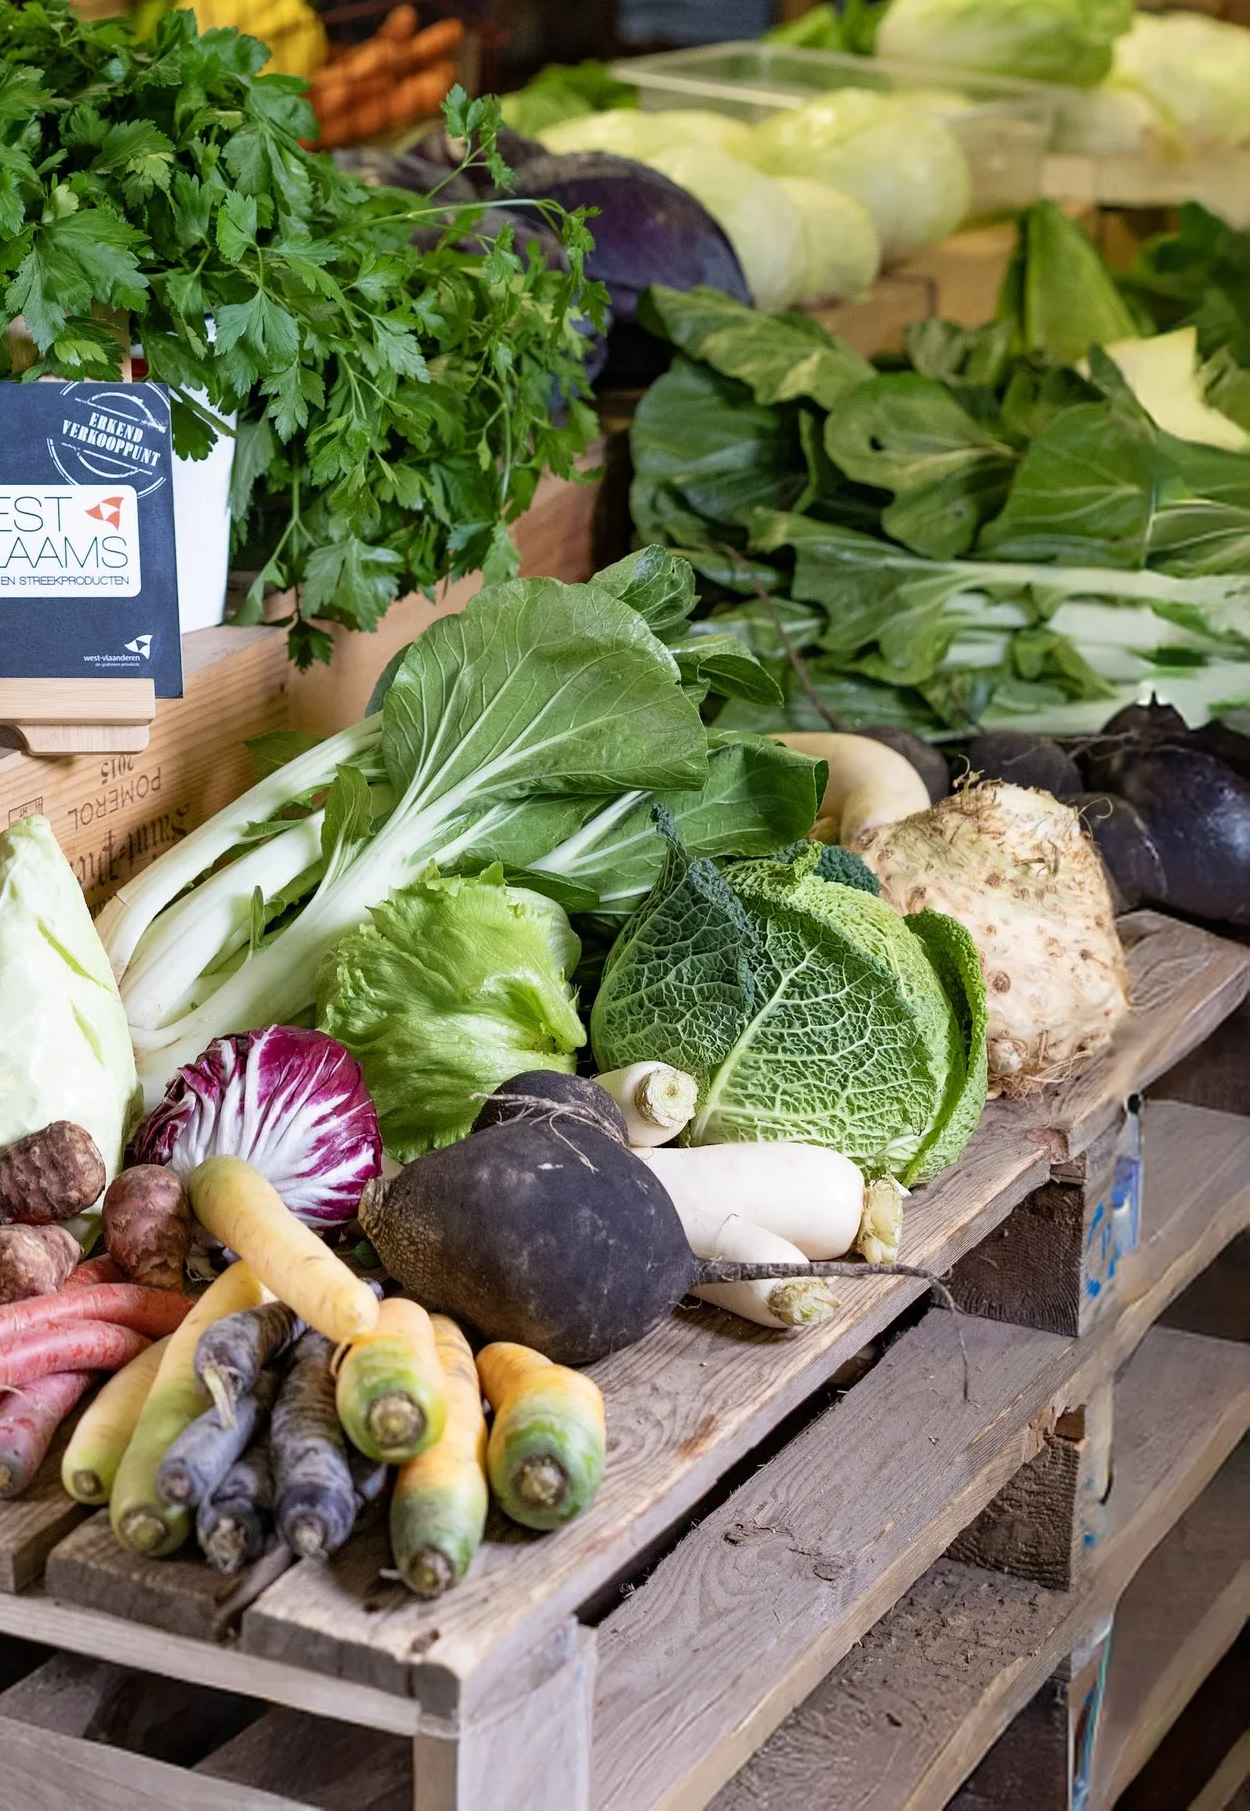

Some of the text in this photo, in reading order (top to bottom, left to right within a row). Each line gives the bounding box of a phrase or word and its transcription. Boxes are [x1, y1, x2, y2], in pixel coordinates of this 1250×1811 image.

[88, 412, 144, 443] ERKEND
[62, 419, 161, 467] VERKOOPPUNT
[1, 576, 16, 586] EN
[19, 575, 129, 586] STREEKPRODUCTEN
[83, 654, 140, 662] west-vlaanderen
[101, 755, 135, 785] 2015
[68, 766, 162, 831] POMEROL
